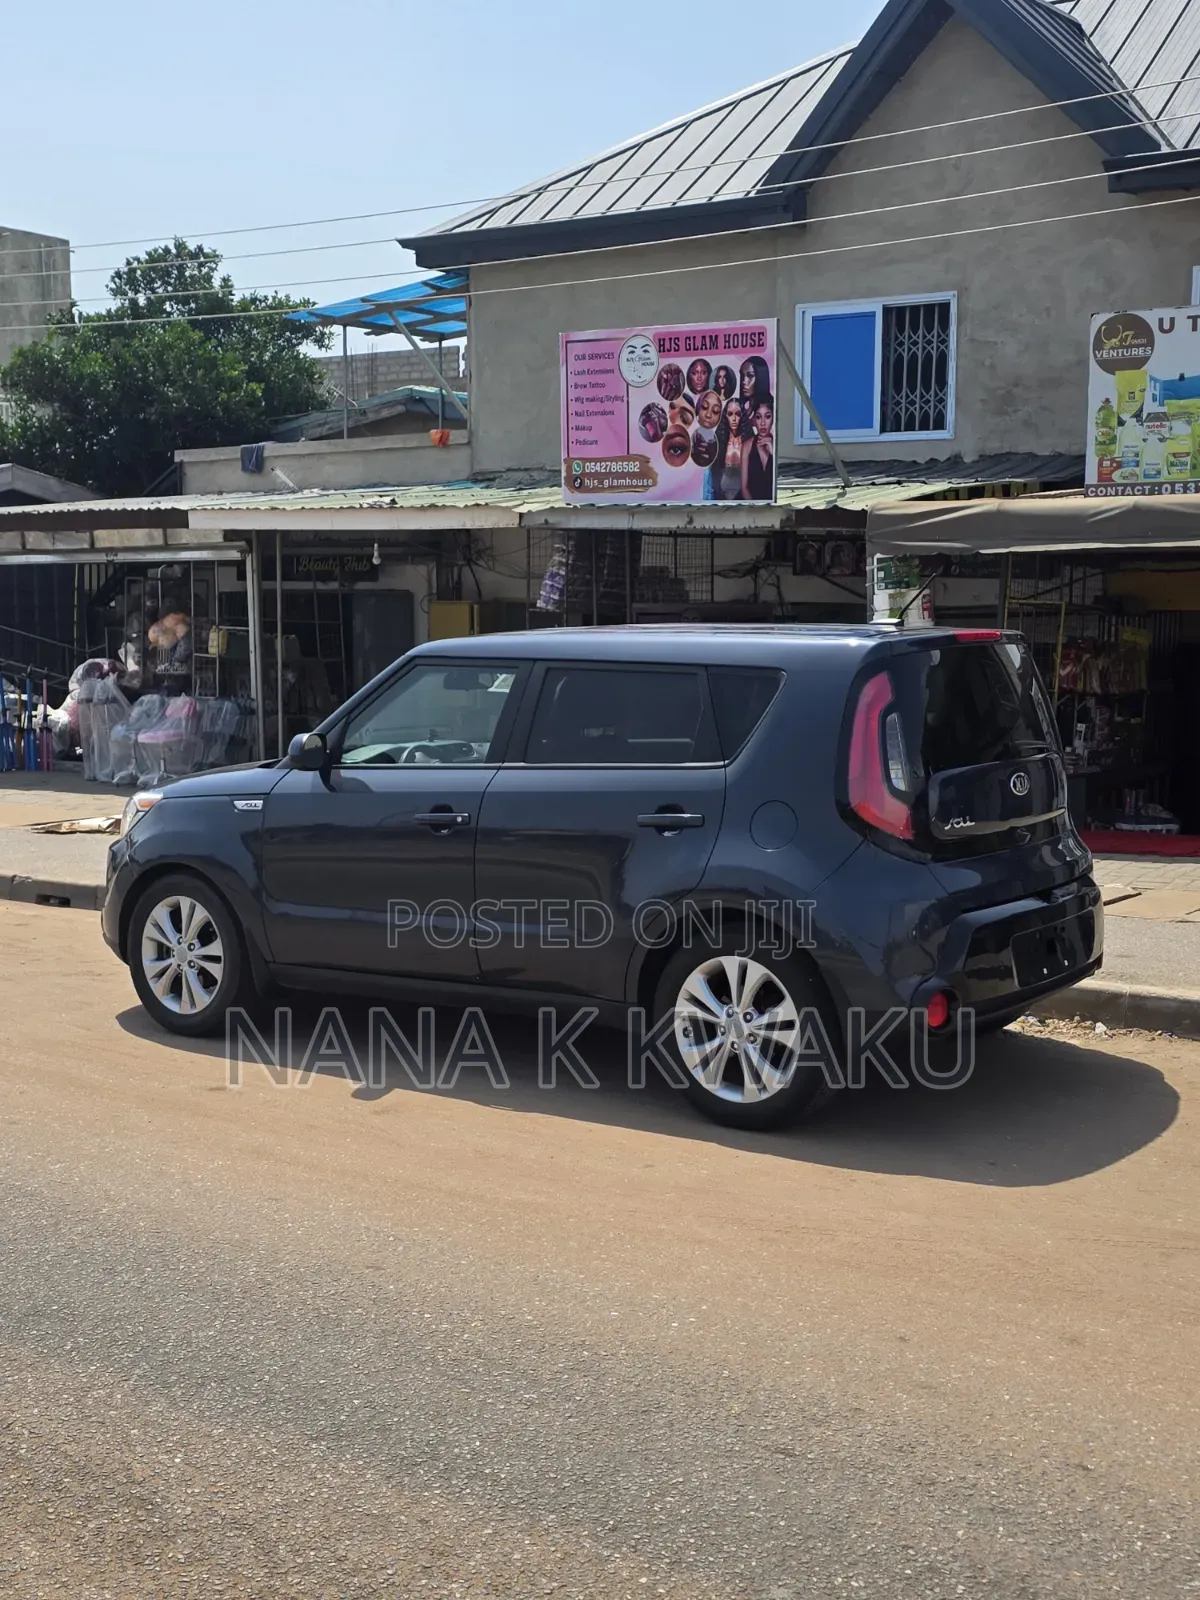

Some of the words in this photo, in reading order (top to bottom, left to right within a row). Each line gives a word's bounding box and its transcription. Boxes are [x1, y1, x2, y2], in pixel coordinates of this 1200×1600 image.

[658, 337, 680, 353] HJS
[685, 334, 719, 352] GLAM
[723, 331, 765, 349] HOUSE
[574, 353, 587, 361] OUR
[588, 352, 615, 360] SERVICES
[1095, 346, 1152, 358] VENTURES
[587, 368, 615, 376] Extensions
[588, 381, 606, 389] Tattoo
[574, 396, 584, 404] Wig
[586, 409, 615, 417] Extensions
[574, 424, 593, 432] Makup
[575, 438, 598, 446] Pedicure
[584, 461, 640, 473] 0542786582
[584, 477, 653, 488] hjs_glamhouse
[1161, 483, 1200, 495] 053
[298, 556, 339, 576] Beauty
[344, 555, 371, 572] Hub
